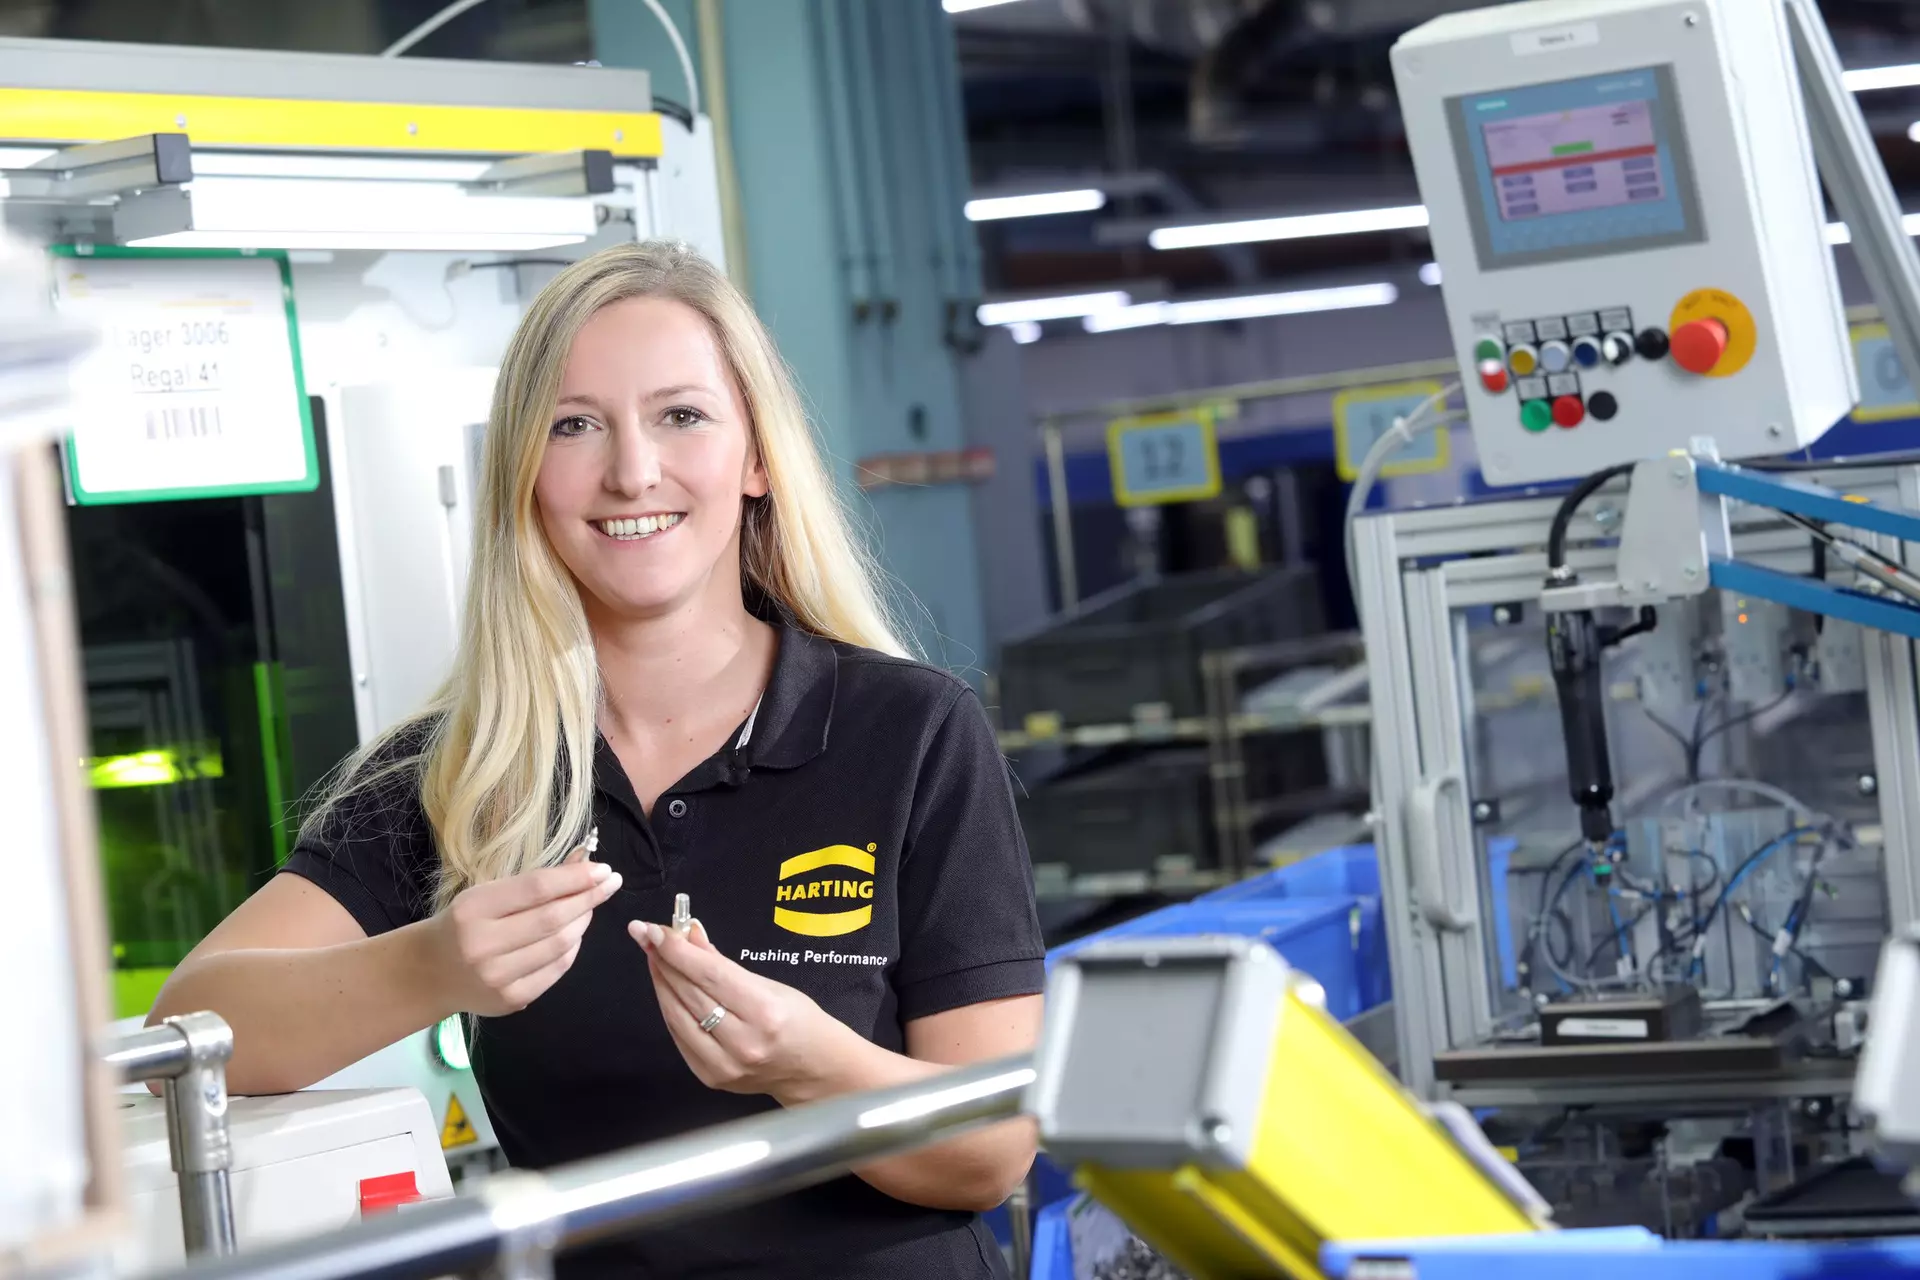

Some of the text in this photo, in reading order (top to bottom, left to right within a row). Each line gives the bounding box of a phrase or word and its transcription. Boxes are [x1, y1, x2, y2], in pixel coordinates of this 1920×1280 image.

[130, 361, 219, 393] Regal 41
[776, 880, 874, 902] HARTING
[740, 949, 888, 966] Pushing Performance
